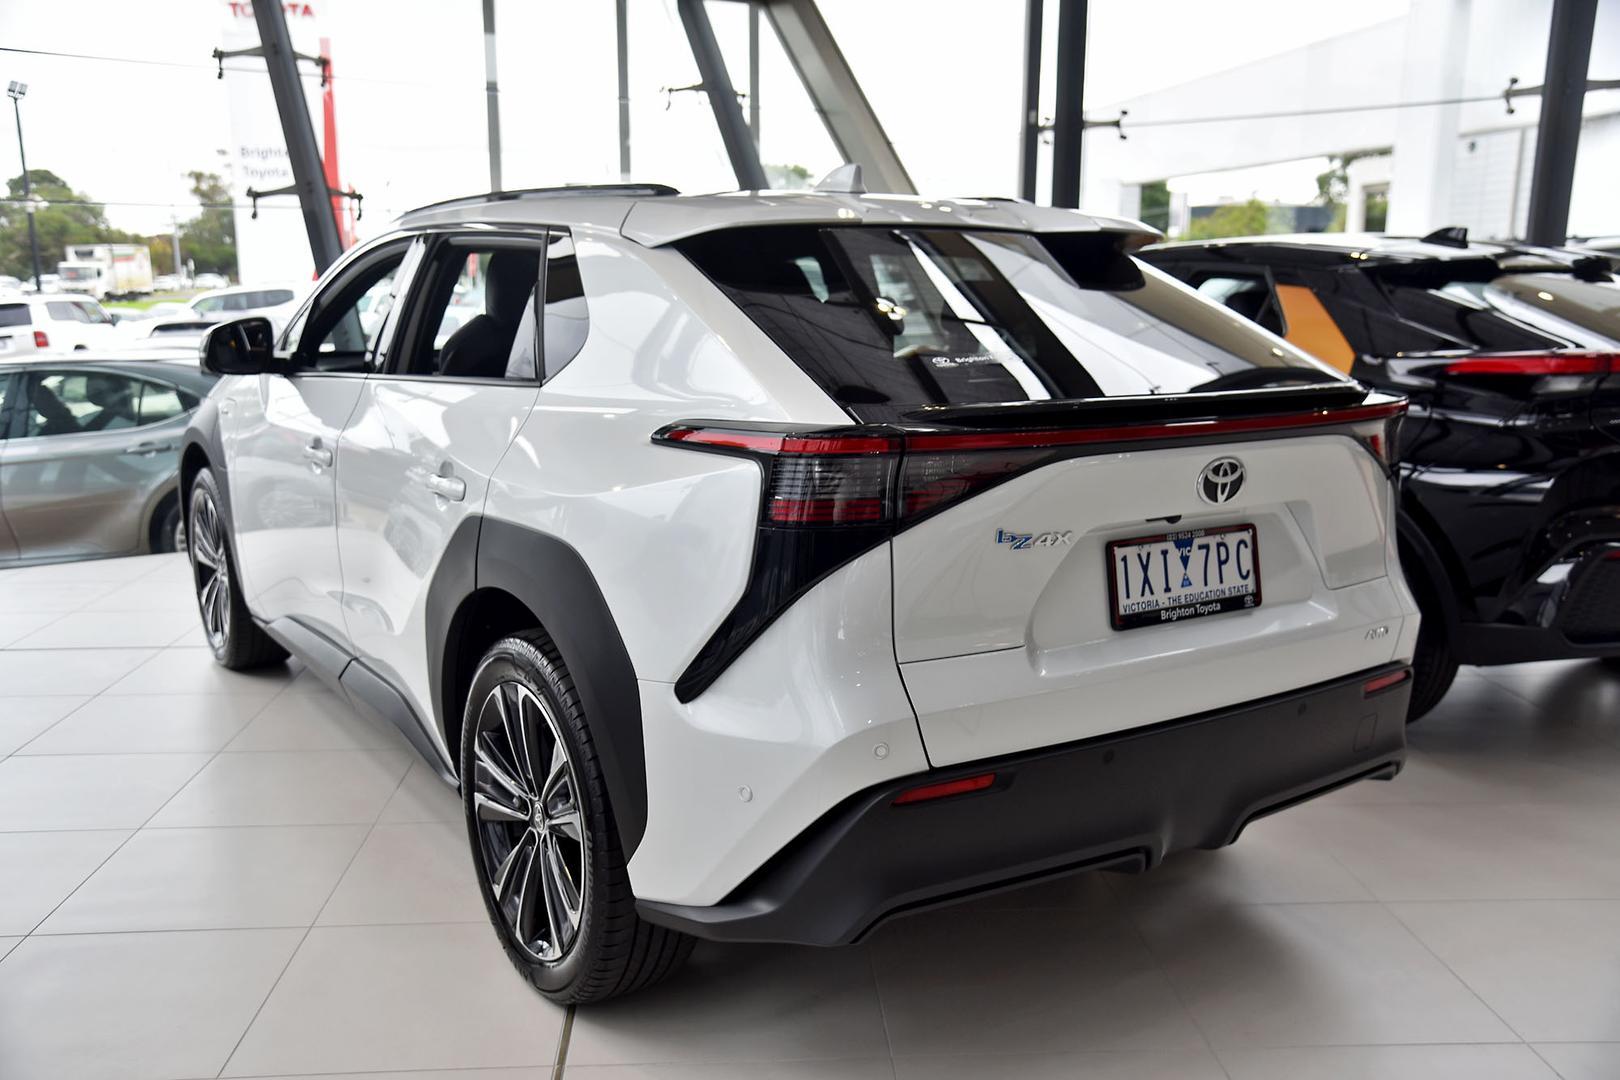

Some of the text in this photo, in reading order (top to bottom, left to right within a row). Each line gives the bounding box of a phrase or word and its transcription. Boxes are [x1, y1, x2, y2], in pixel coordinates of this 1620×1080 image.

[228, 2, 315, 18] TOTA
[1179, 546, 1191, 557] VIC
[1198, 539, 1251, 587] 7PC
[1122, 599, 1160, 613] VICTORIA
[1167, 595, 1183, 606] THE
[1184, 589, 1226, 602] EDUCATION
[1227, 584, 1250, 597] STATE
[1160, 601, 1221, 620] Brighton Toyota
